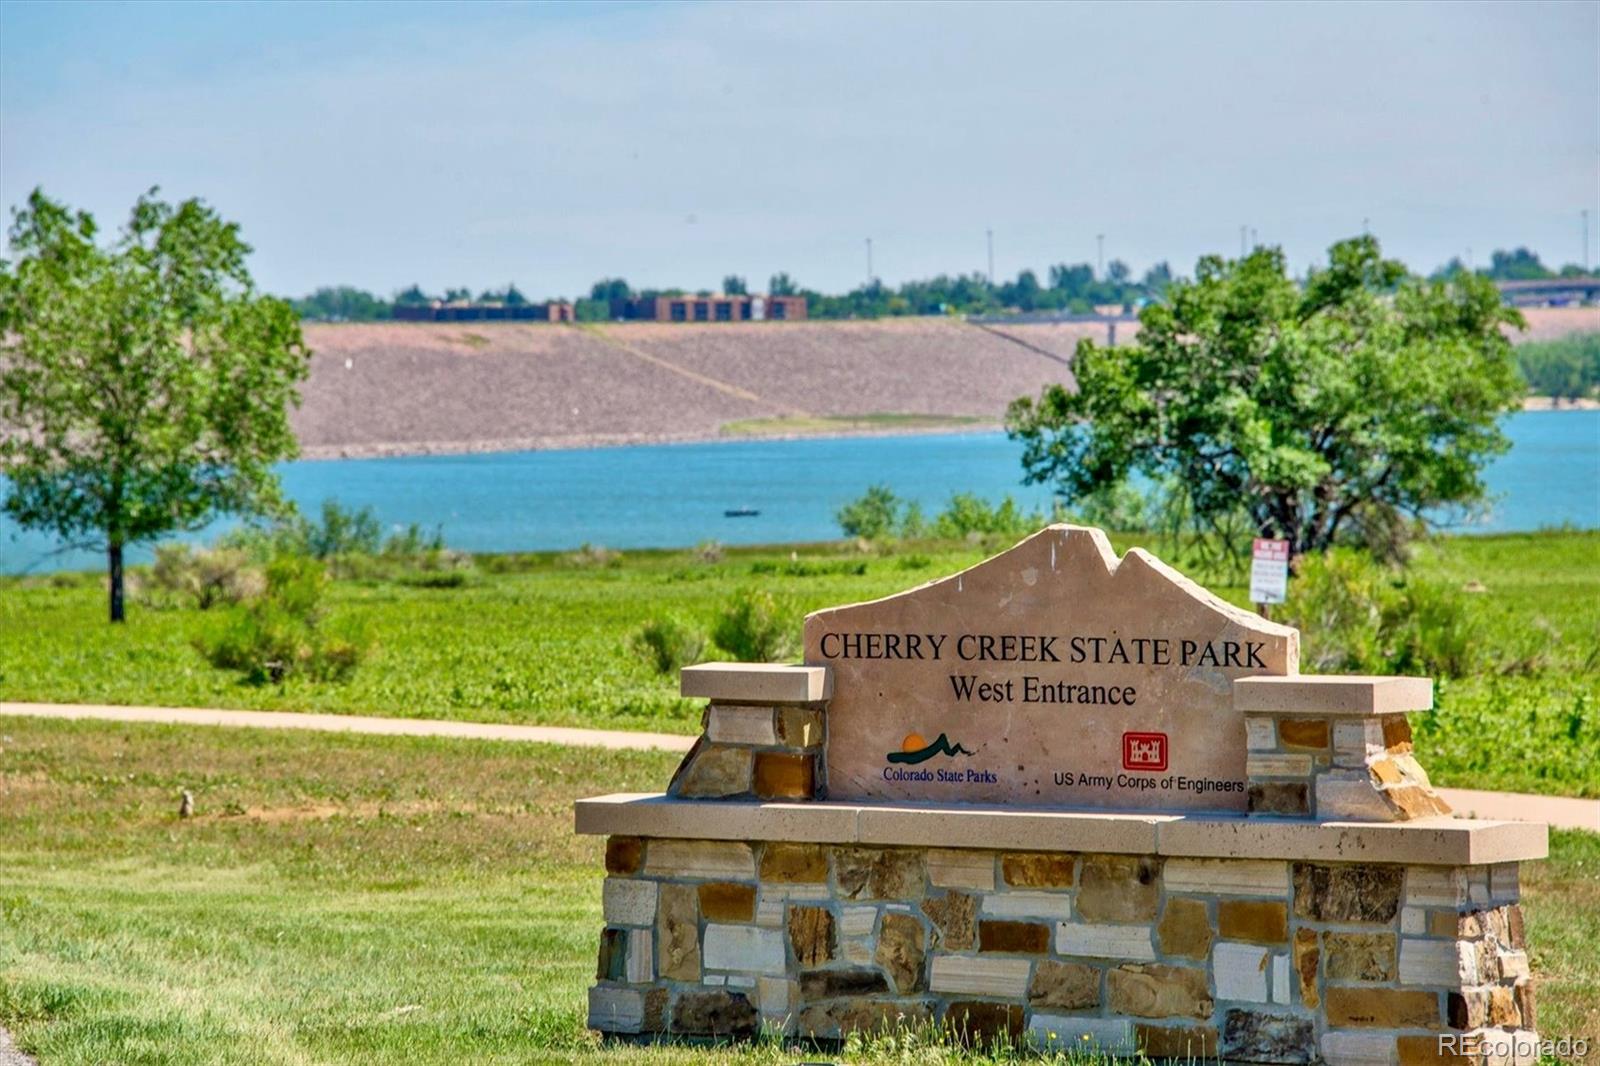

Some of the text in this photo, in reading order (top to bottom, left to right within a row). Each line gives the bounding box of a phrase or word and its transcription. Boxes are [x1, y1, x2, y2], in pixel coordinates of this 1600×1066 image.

[820, 632, 1268, 668] CHERRY CREEK STATE PARK
[949, 675, 1137, 706] West Entrance
[883, 767, 998, 784] Colorado State Parks
[1054, 772, 1245, 794] US Army Corps of Engineers
